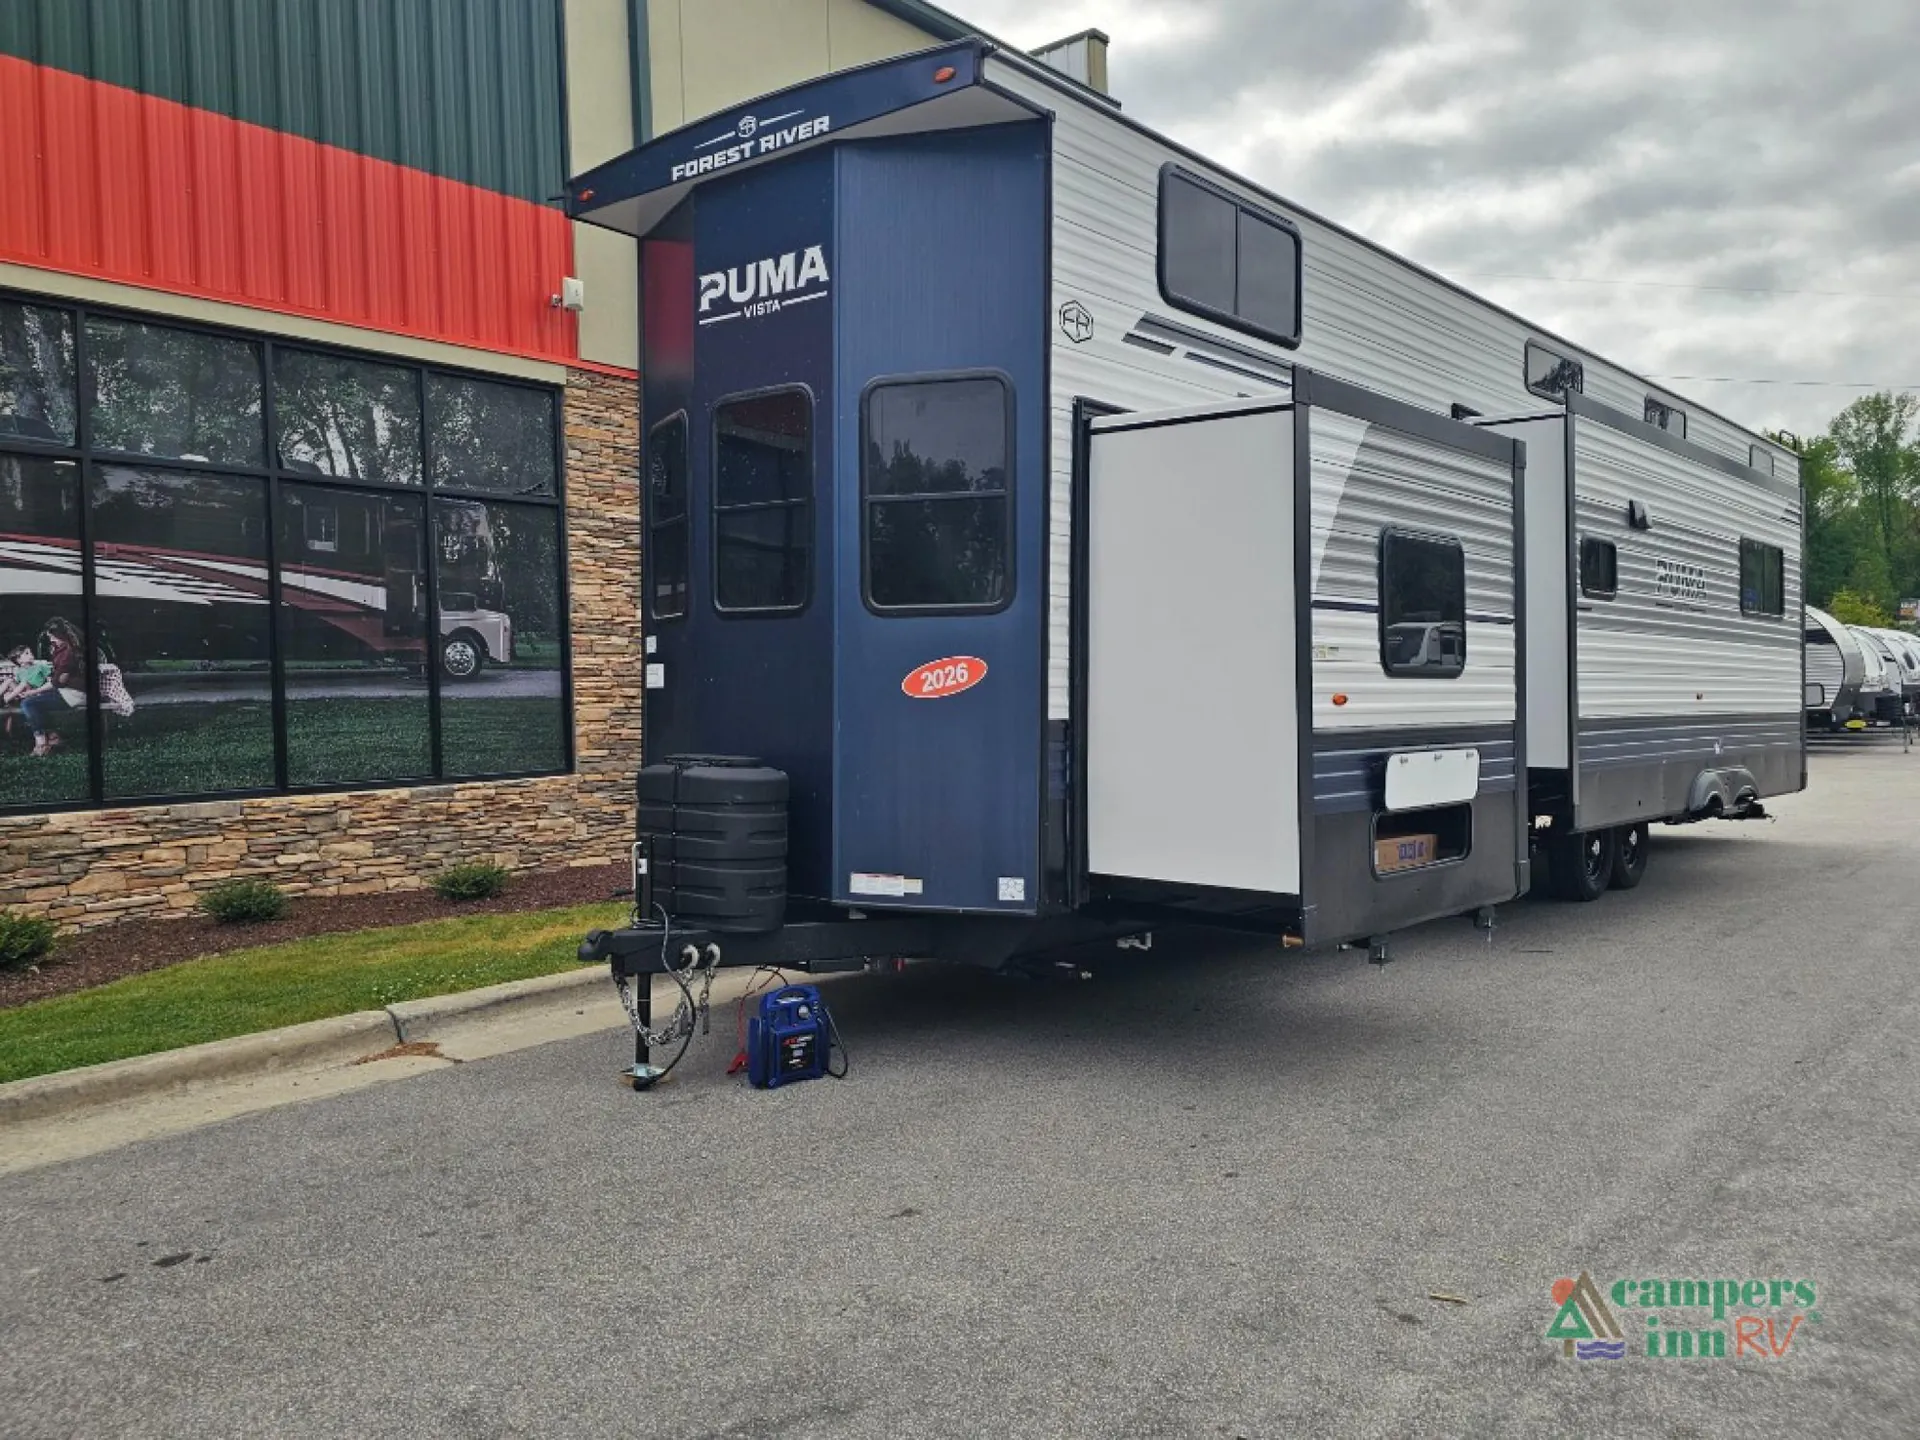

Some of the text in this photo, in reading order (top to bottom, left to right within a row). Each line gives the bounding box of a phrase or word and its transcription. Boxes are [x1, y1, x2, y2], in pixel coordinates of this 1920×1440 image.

[672, 140, 755, 182] FOREST
[759, 115, 830, 153] RIVER
[699, 245, 829, 311] PUMA
[743, 299, 781, 318] VISTA
[920, 662, 969, 693] 2026
